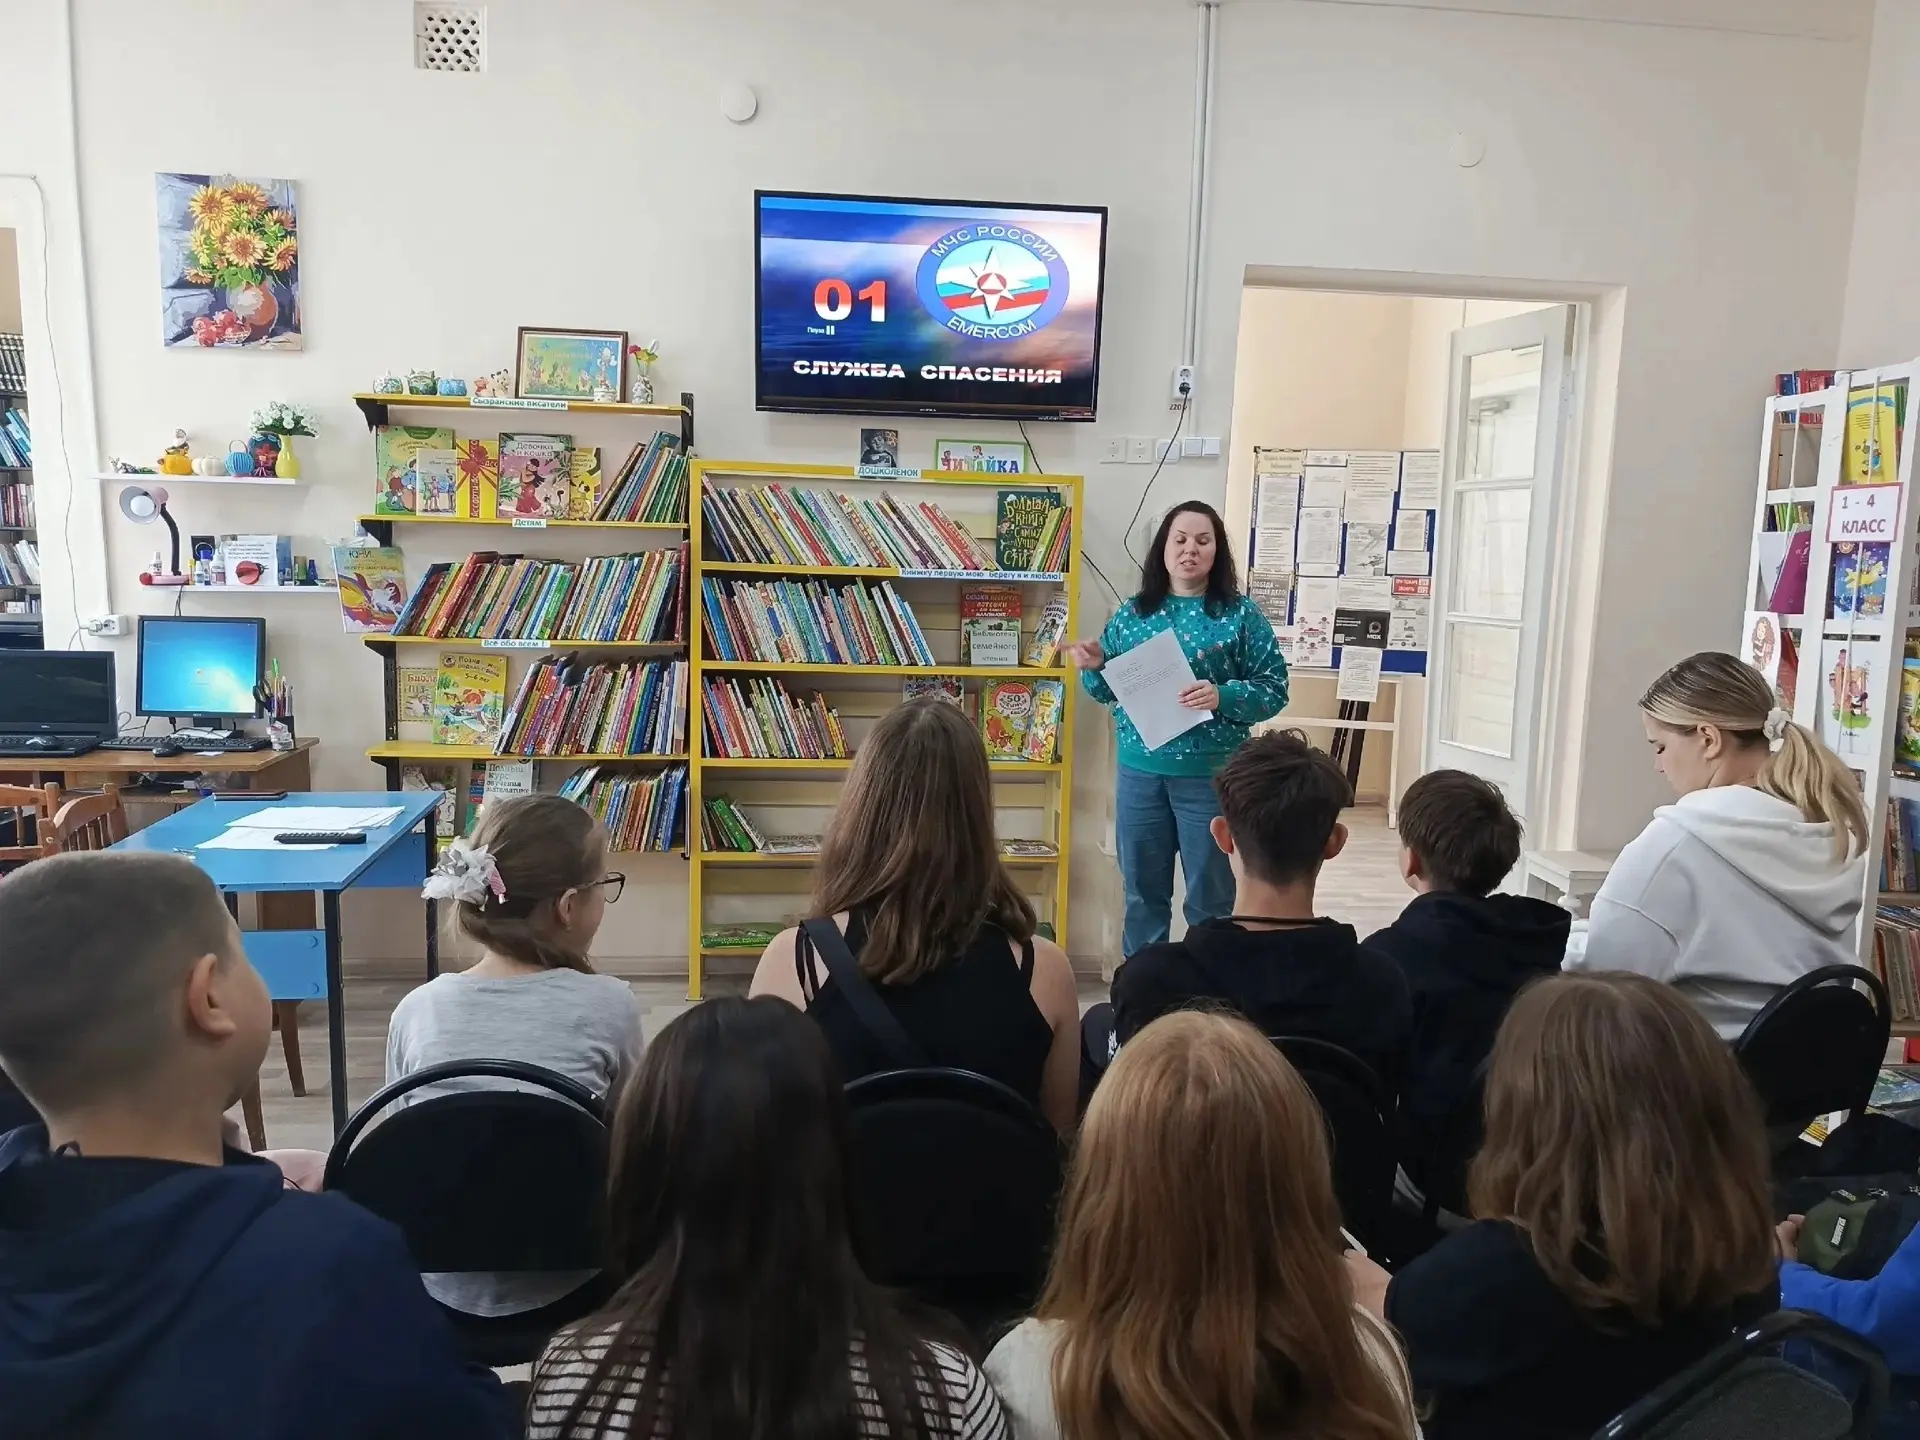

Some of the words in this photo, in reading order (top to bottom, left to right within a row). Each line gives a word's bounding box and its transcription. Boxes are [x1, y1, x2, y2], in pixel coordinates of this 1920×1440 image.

[930, 230, 971, 258] МЧС
[976, 226, 1059, 262] РОССИИ
[813, 279, 888, 323] 01
[946, 316, 1037, 339] EMERCOM
[793, 360, 906, 379] СЛУЖБА
[920, 364, 1063, 384] СПАСЕНИЯ
[472, 397, 525, 408] Сызранские
[527, 400, 567, 409] писатели
[516, 442, 554, 450] Девочка
[941, 456, 1020, 474] ЧИТАЙКА
[857, 466, 919, 477] ДОШКОЛЕНОК
[1841, 496, 1848, 509] 1
[1866, 493, 1875, 508] 4
[513, 519, 542, 527] Детям
[1841, 518, 1886, 534] КЛАСС
[1003, 550, 1030, 568] СТИ
[901, 569, 933, 578] Книжку
[934, 570, 964, 578] первую
[988, 571, 1015, 579] Берегу
[1030, 571, 1061, 579] люблю!
[972, 642, 1017, 651] семейного
[1006, 694, 1021, 703] 50
[488, 763, 524, 773] Полный
[486, 780, 522, 788] обучения
